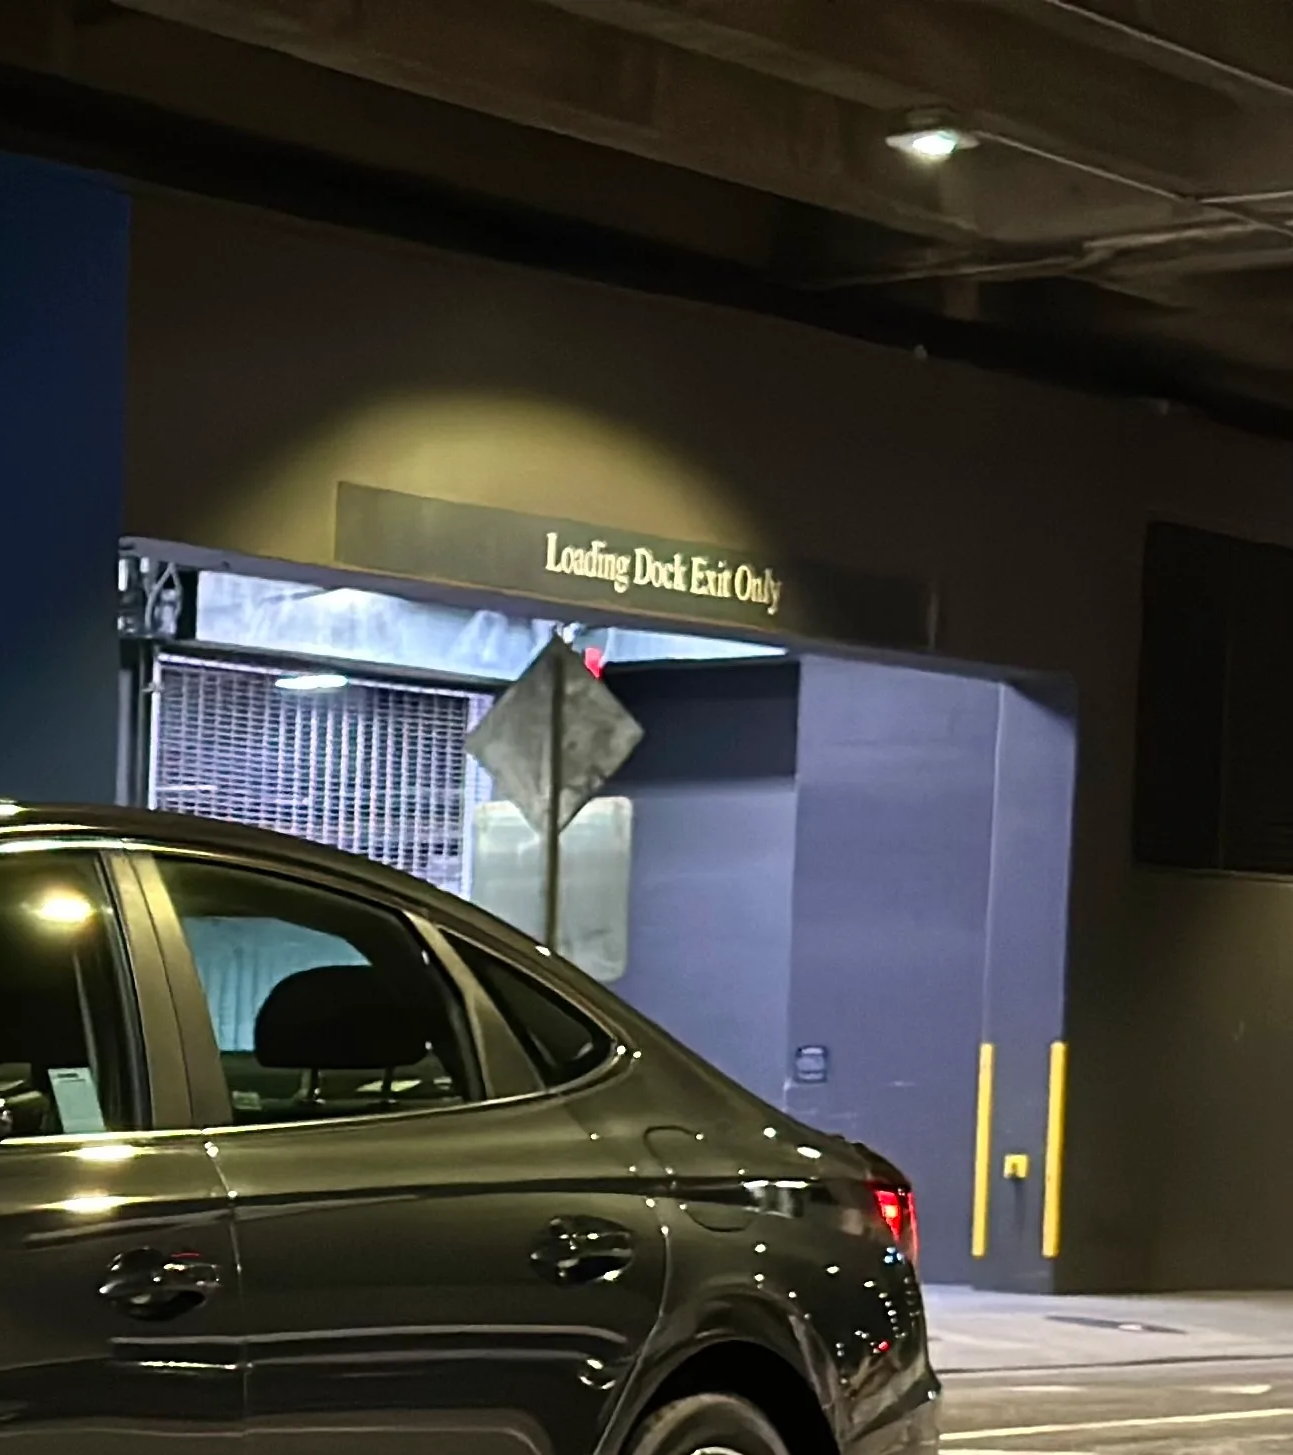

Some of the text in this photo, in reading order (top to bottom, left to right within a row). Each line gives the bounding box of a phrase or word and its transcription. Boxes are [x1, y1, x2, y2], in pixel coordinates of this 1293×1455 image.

[545, 532, 782, 615] Loading Dock Exit Only
